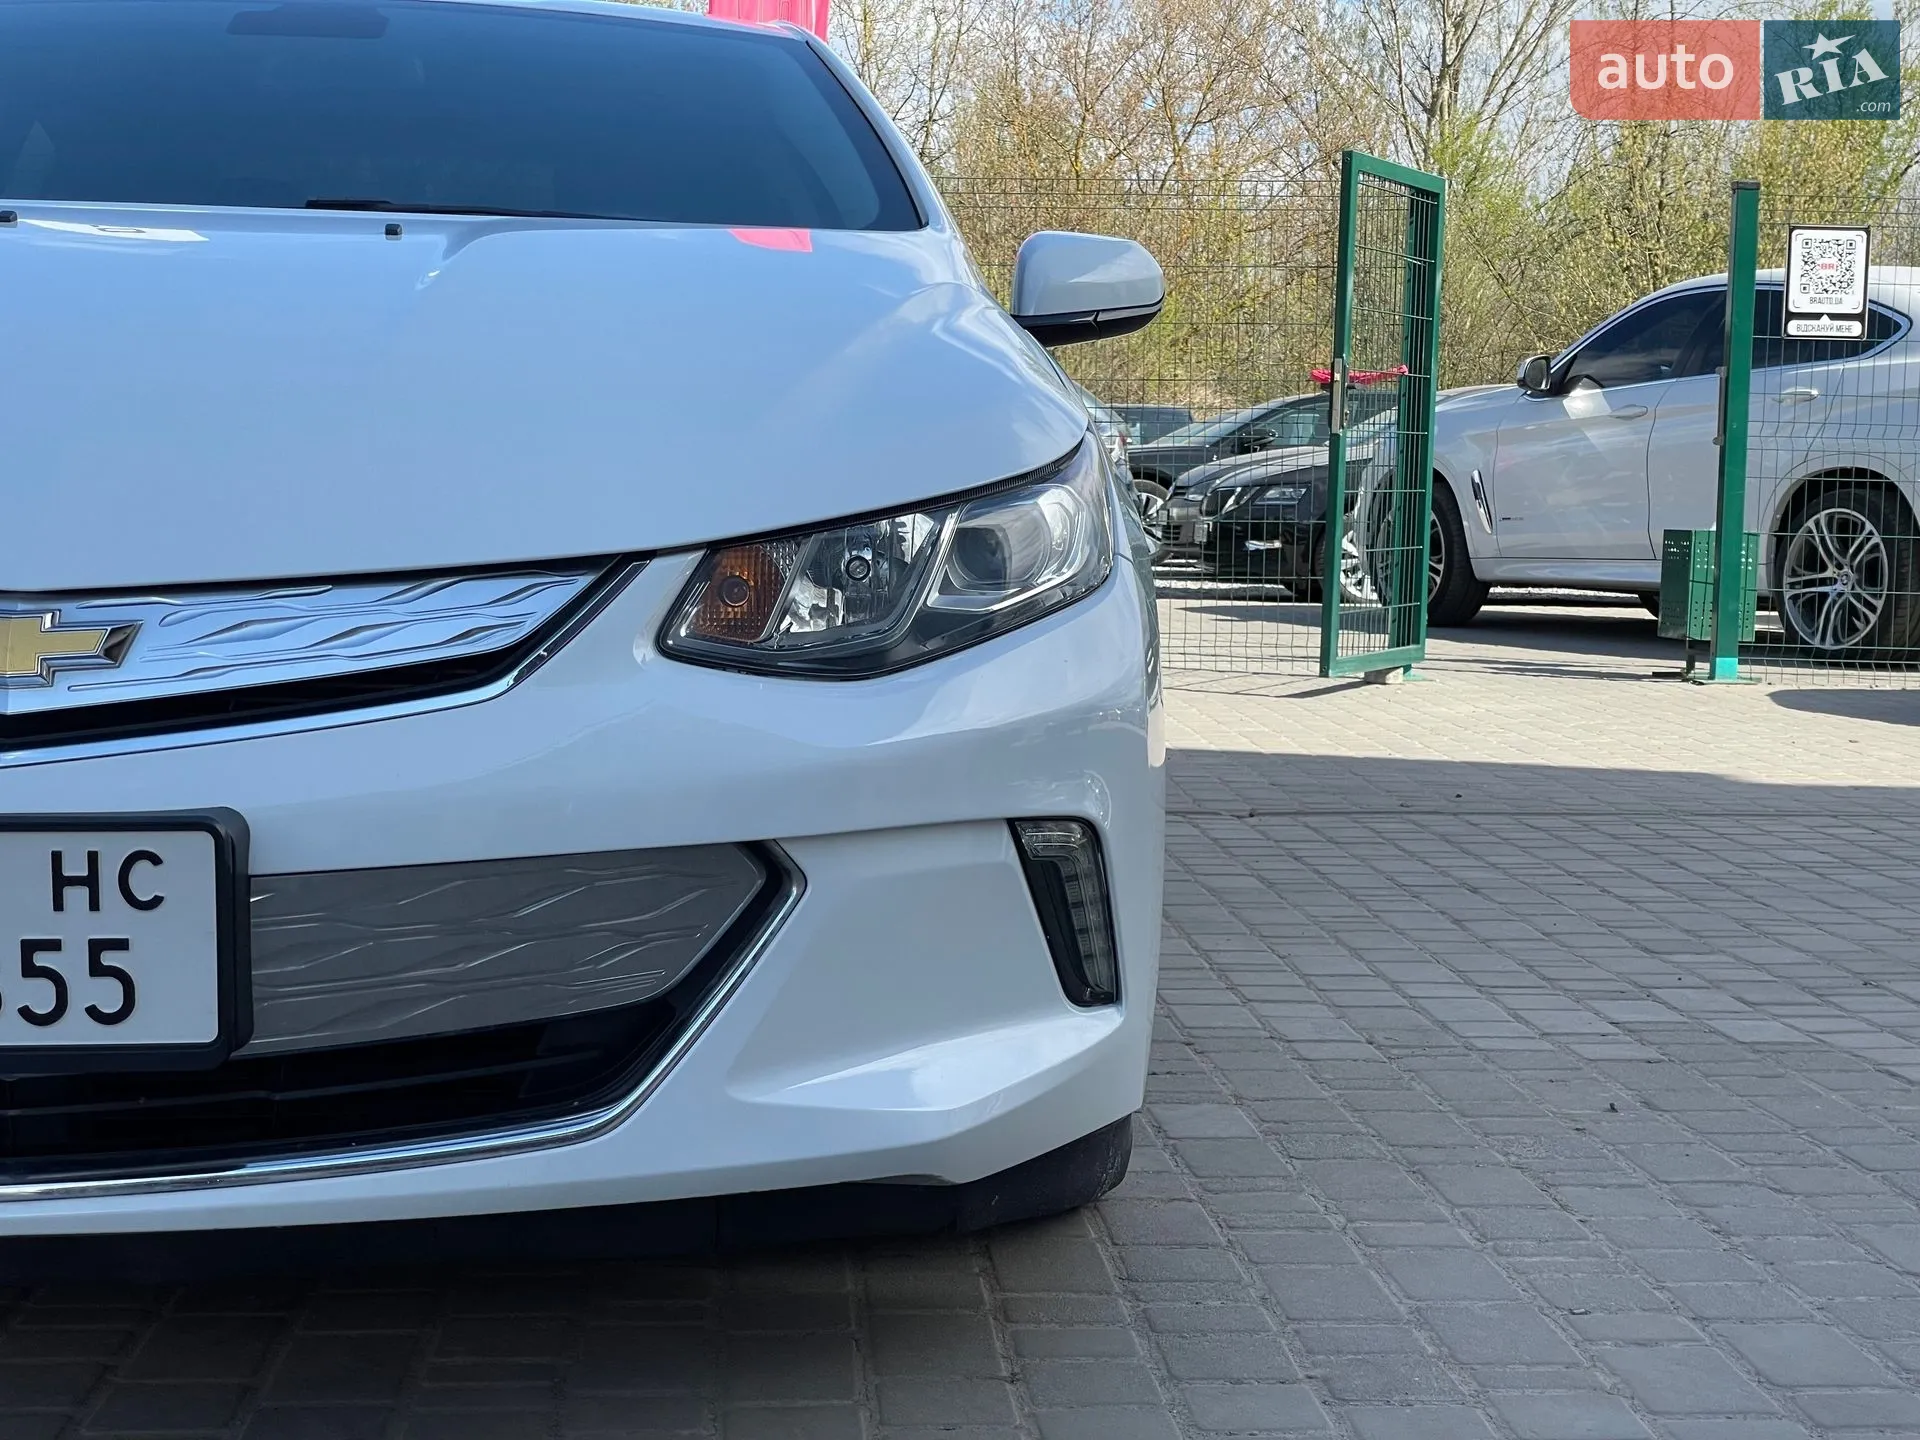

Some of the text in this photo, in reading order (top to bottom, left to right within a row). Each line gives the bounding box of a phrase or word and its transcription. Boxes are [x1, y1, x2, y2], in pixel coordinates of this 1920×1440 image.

[1796, 323, 1853, 333] ВІДСКАНУЙ МЕНЕ
[51, 849, 165, 912] HC
[0, 937, 136, 1026] 55
